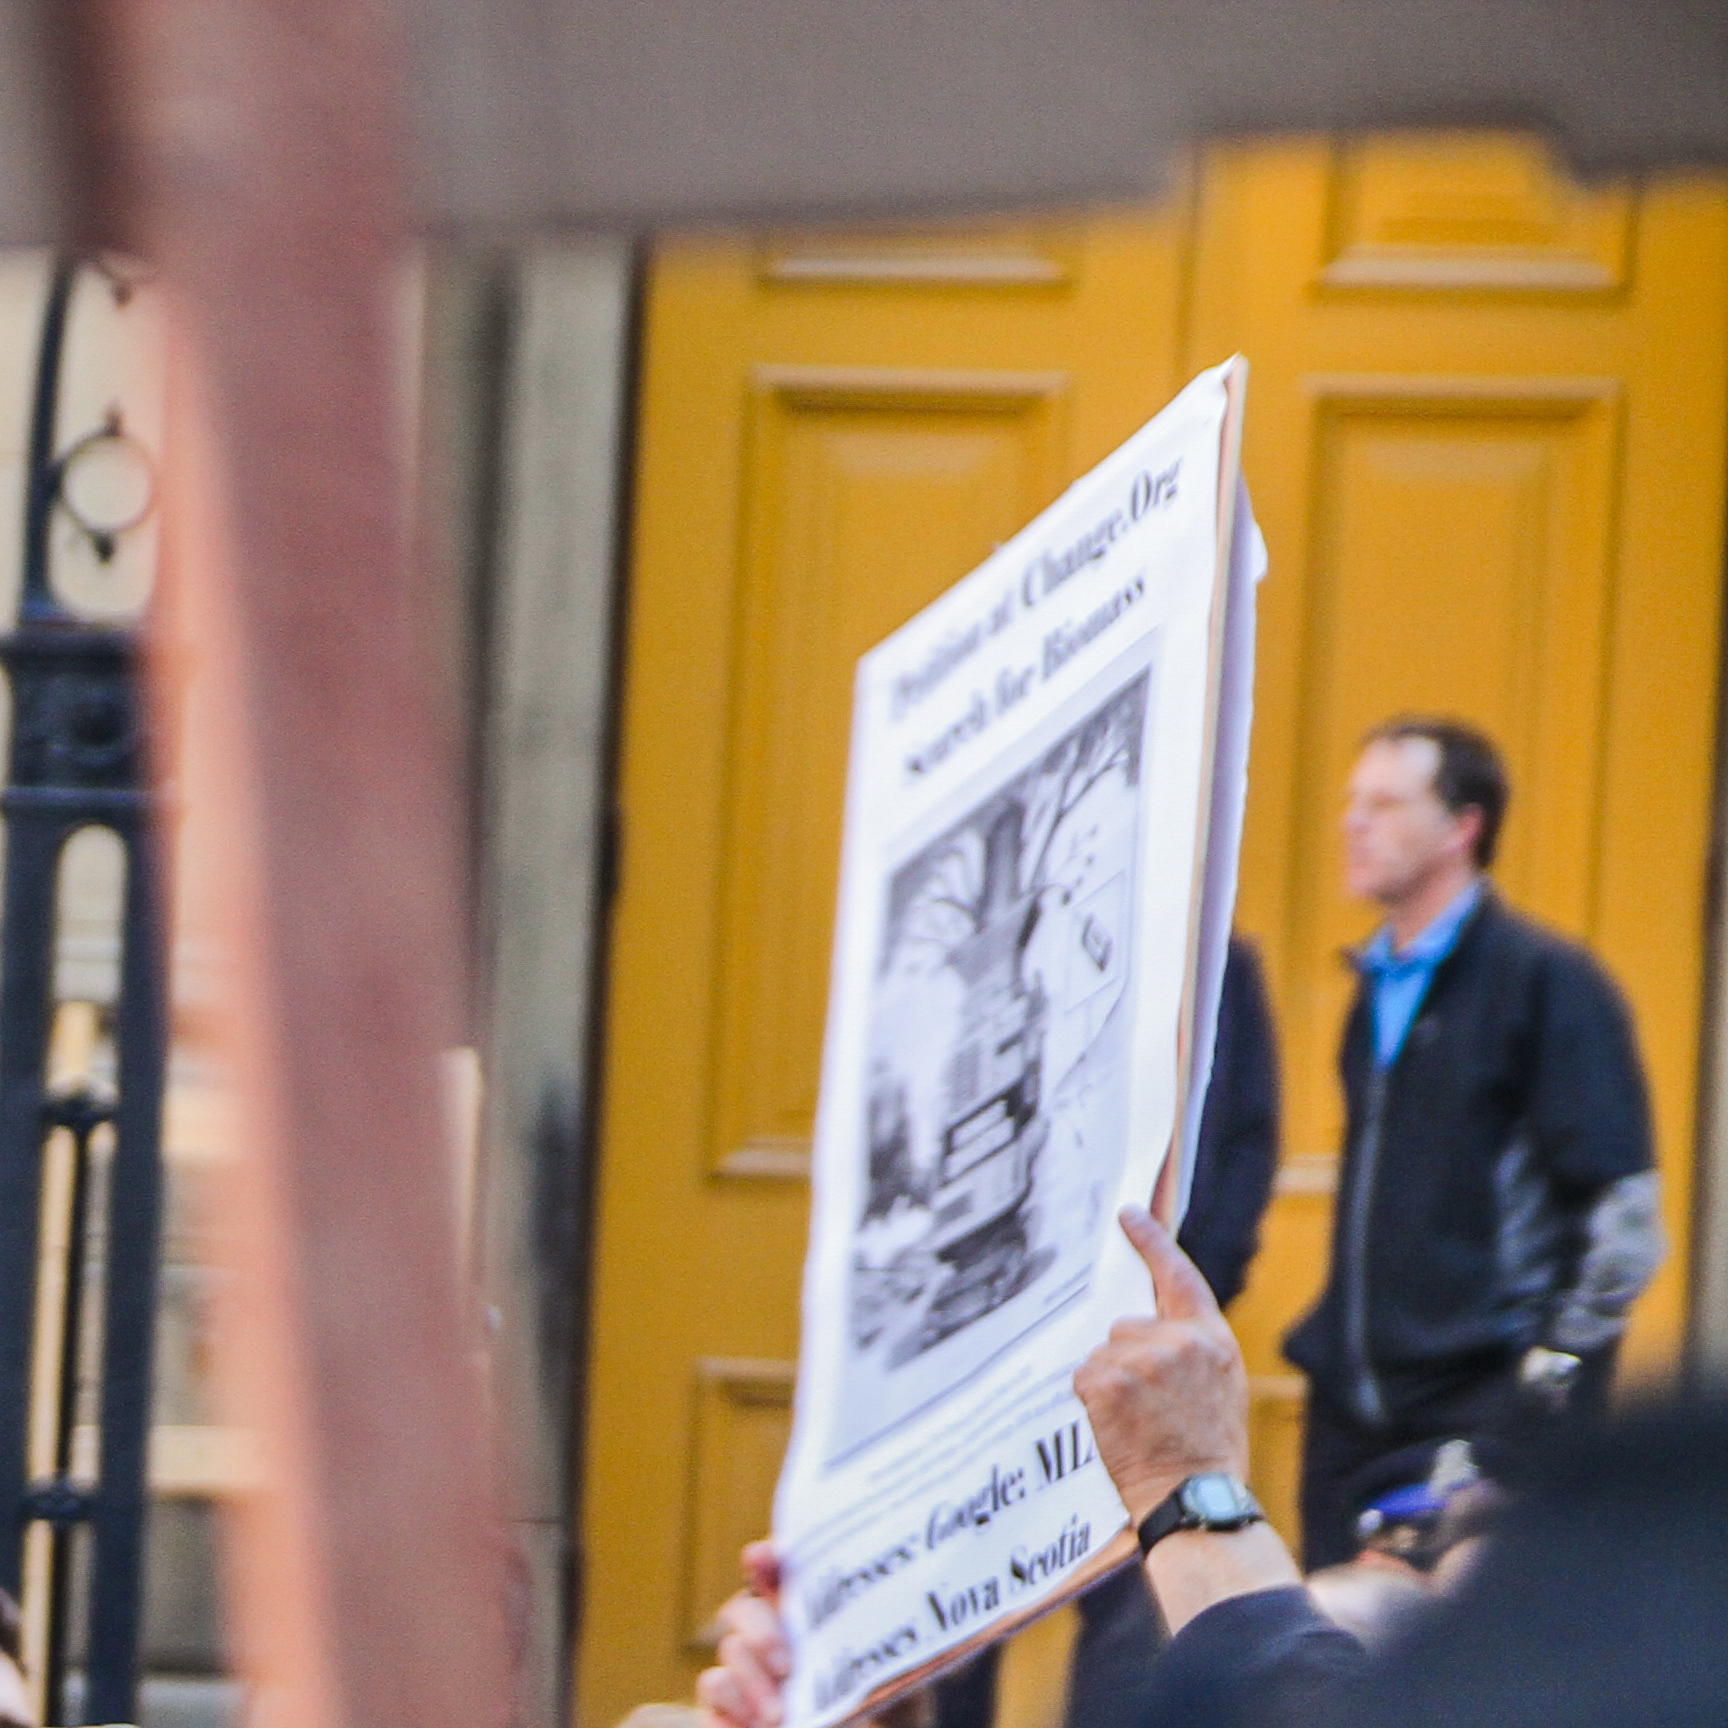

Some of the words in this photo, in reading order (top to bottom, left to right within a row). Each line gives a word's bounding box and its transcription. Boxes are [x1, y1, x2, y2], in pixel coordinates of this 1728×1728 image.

[1043, 570, 1146, 682] Biomass
[1034, 1418, 1097, 1492] ML
[925, 1576, 1001, 1633] Nova
[1008, 1513, 1093, 1595] Scotia
